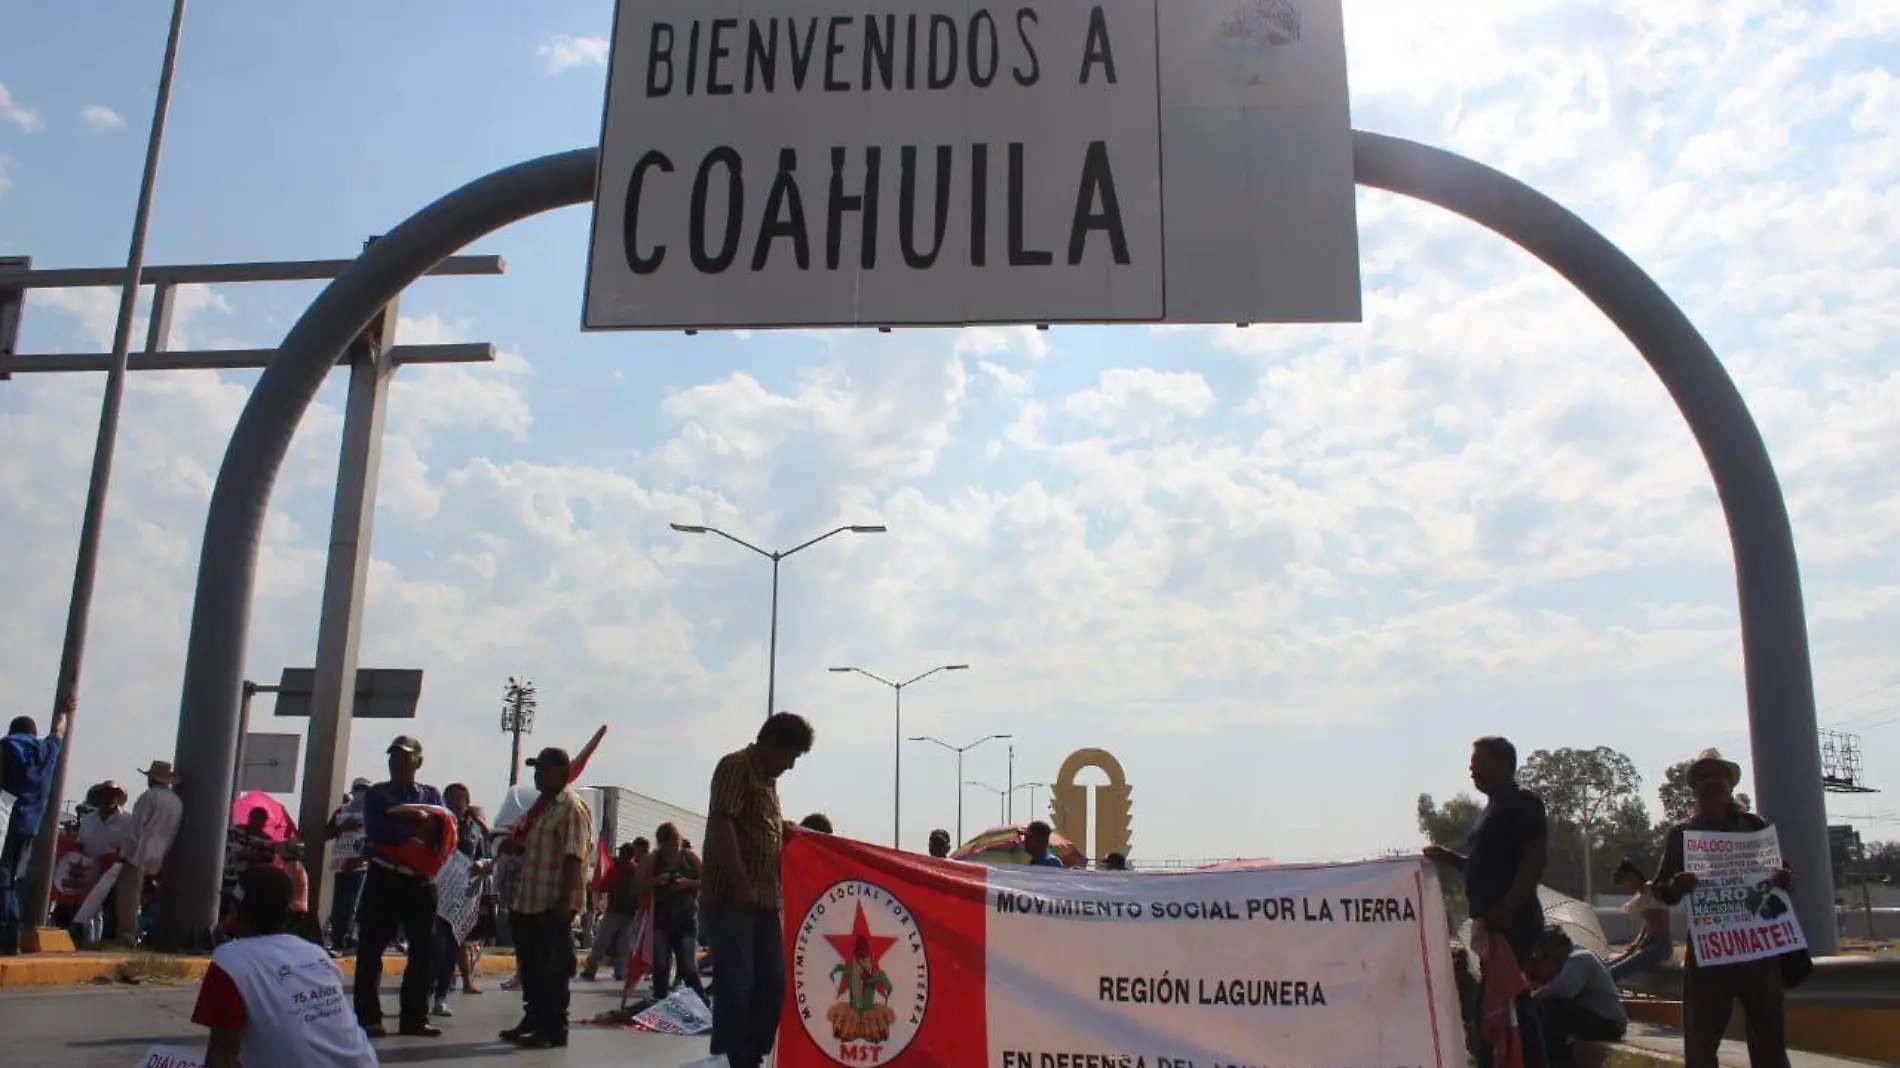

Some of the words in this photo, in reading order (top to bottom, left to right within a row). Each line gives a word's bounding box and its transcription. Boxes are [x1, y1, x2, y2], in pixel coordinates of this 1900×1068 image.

[646, 7, 1040, 98] BIENVENIDOS
[1079, 5, 1118, 85] A
[623, 140, 1131, 275] COAHUILA
[829, 884, 879, 903] SOCIAL
[997, 891, 1143, 919] MOVIMIENTO
[1151, 901, 1240, 919] SOCIAL
[1246, 897, 1296, 921] POR
[1303, 897, 1334, 922] LA
[1340, 897, 1416, 922] TIERRA
[1693, 889, 1748, 902] PARO
[885, 899, 910, 926] POR
[908, 931, 921, 953] LA
[796, 903, 826, 1020] MOVIMIENTO
[908, 964, 926, 1025] TIERRA
[1099, 970, 1190, 1005] REGIÓN
[1199, 979, 1327, 1006] LAGUNERA
[839, 1045, 882, 1062] MST
